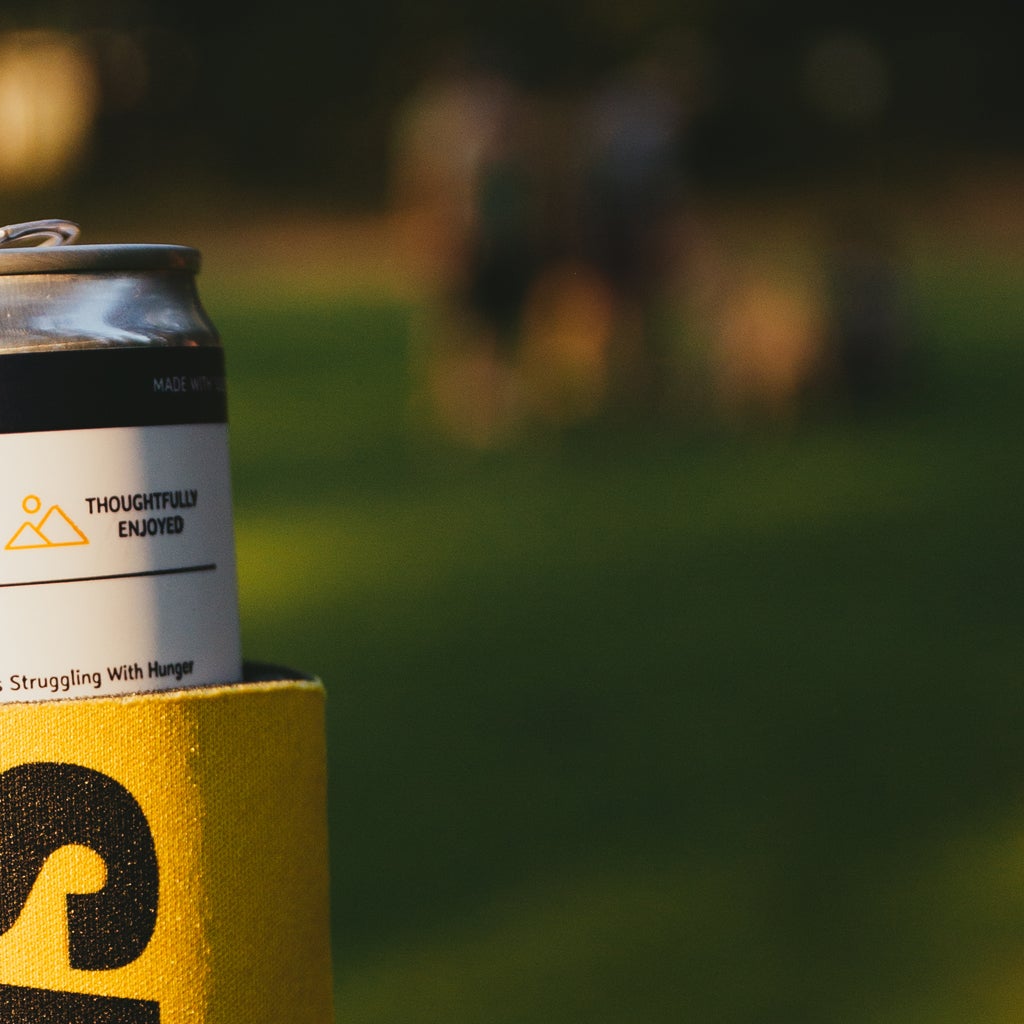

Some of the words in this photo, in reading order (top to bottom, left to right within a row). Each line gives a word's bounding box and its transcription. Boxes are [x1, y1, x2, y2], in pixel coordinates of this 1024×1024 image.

[153, 376, 187, 392] MADE
[85, 488, 199, 514] THOUGHTFULLY
[118, 514, 185, 538] ENJOYED
[9, 669, 102, 696] Struggling
[106, 662, 144, 682] With
[146, 659, 195, 682] Hunger
